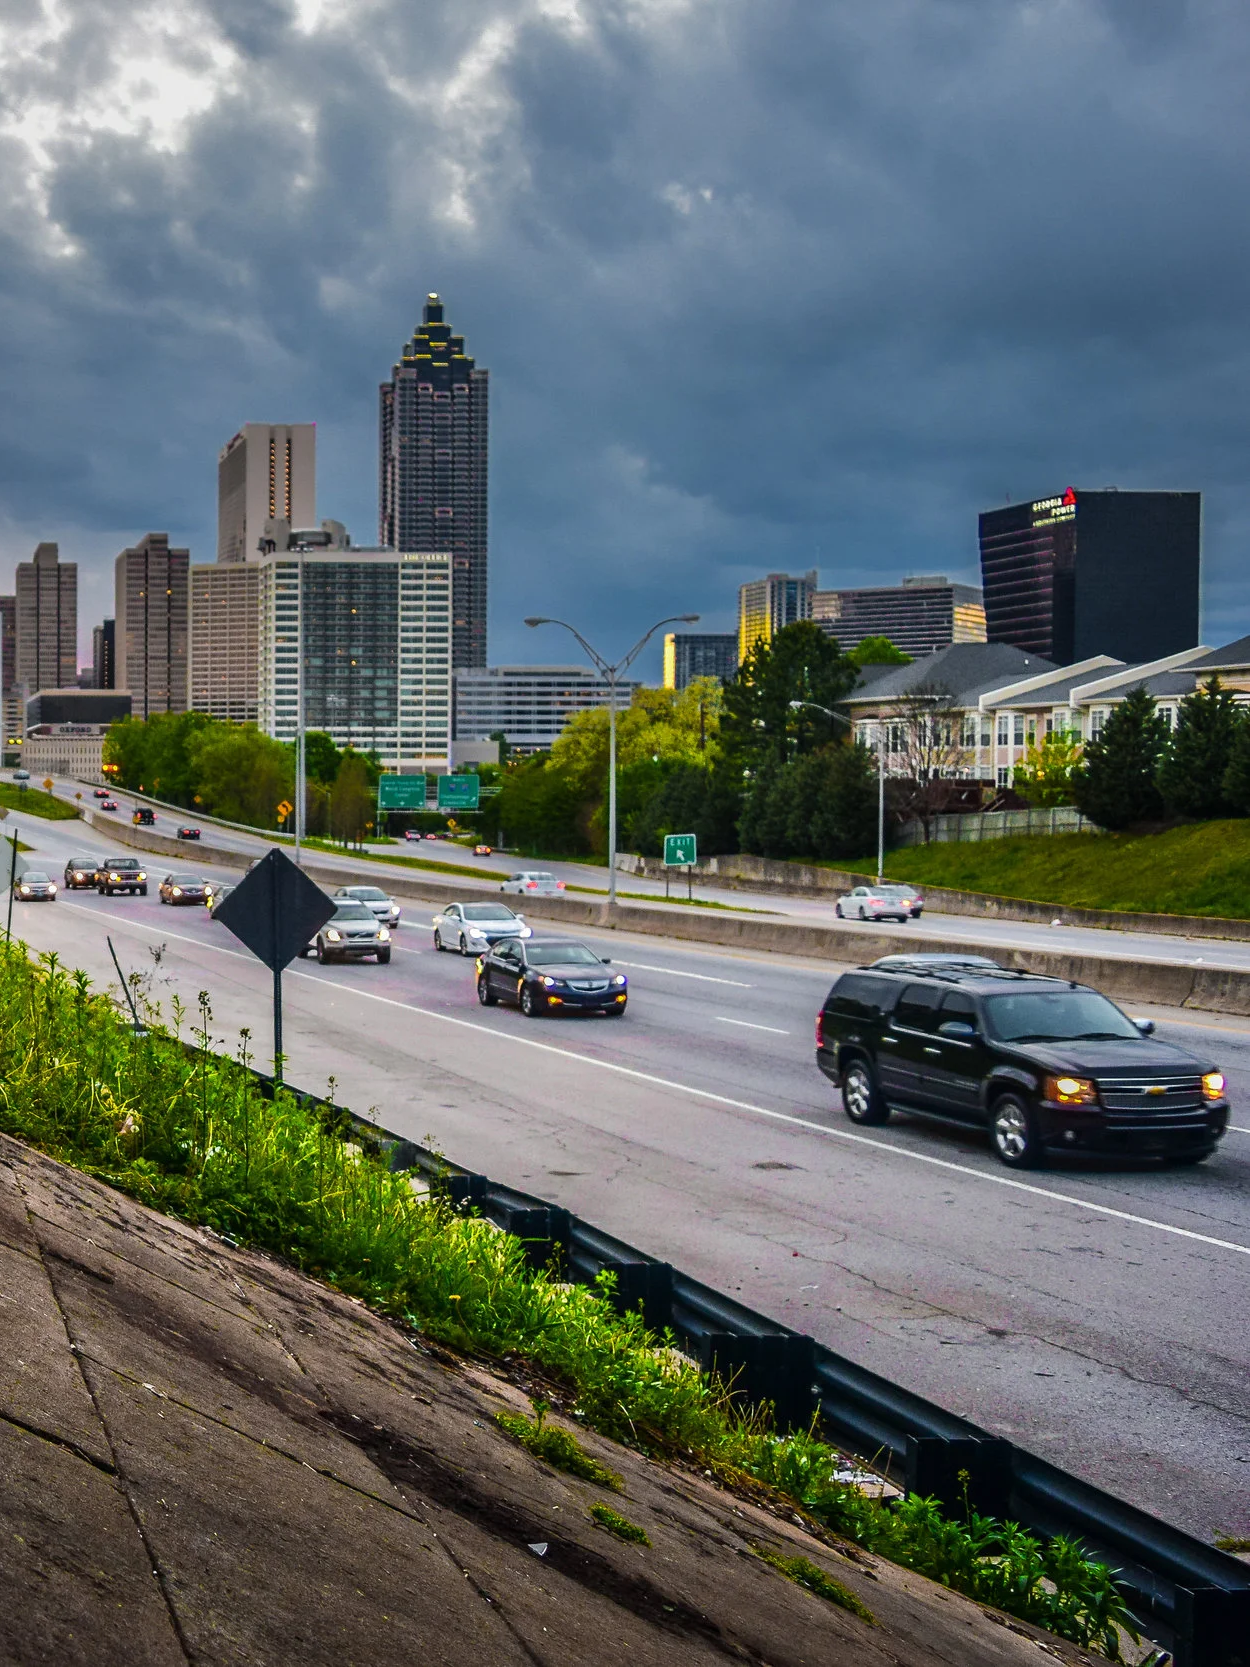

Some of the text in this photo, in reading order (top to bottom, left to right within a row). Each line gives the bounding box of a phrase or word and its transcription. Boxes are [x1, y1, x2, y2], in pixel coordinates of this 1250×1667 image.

[1032, 497, 1062, 512] GEORGIA
[1051, 504, 1076, 517] POWER
[670, 837, 691, 846] EXIT
